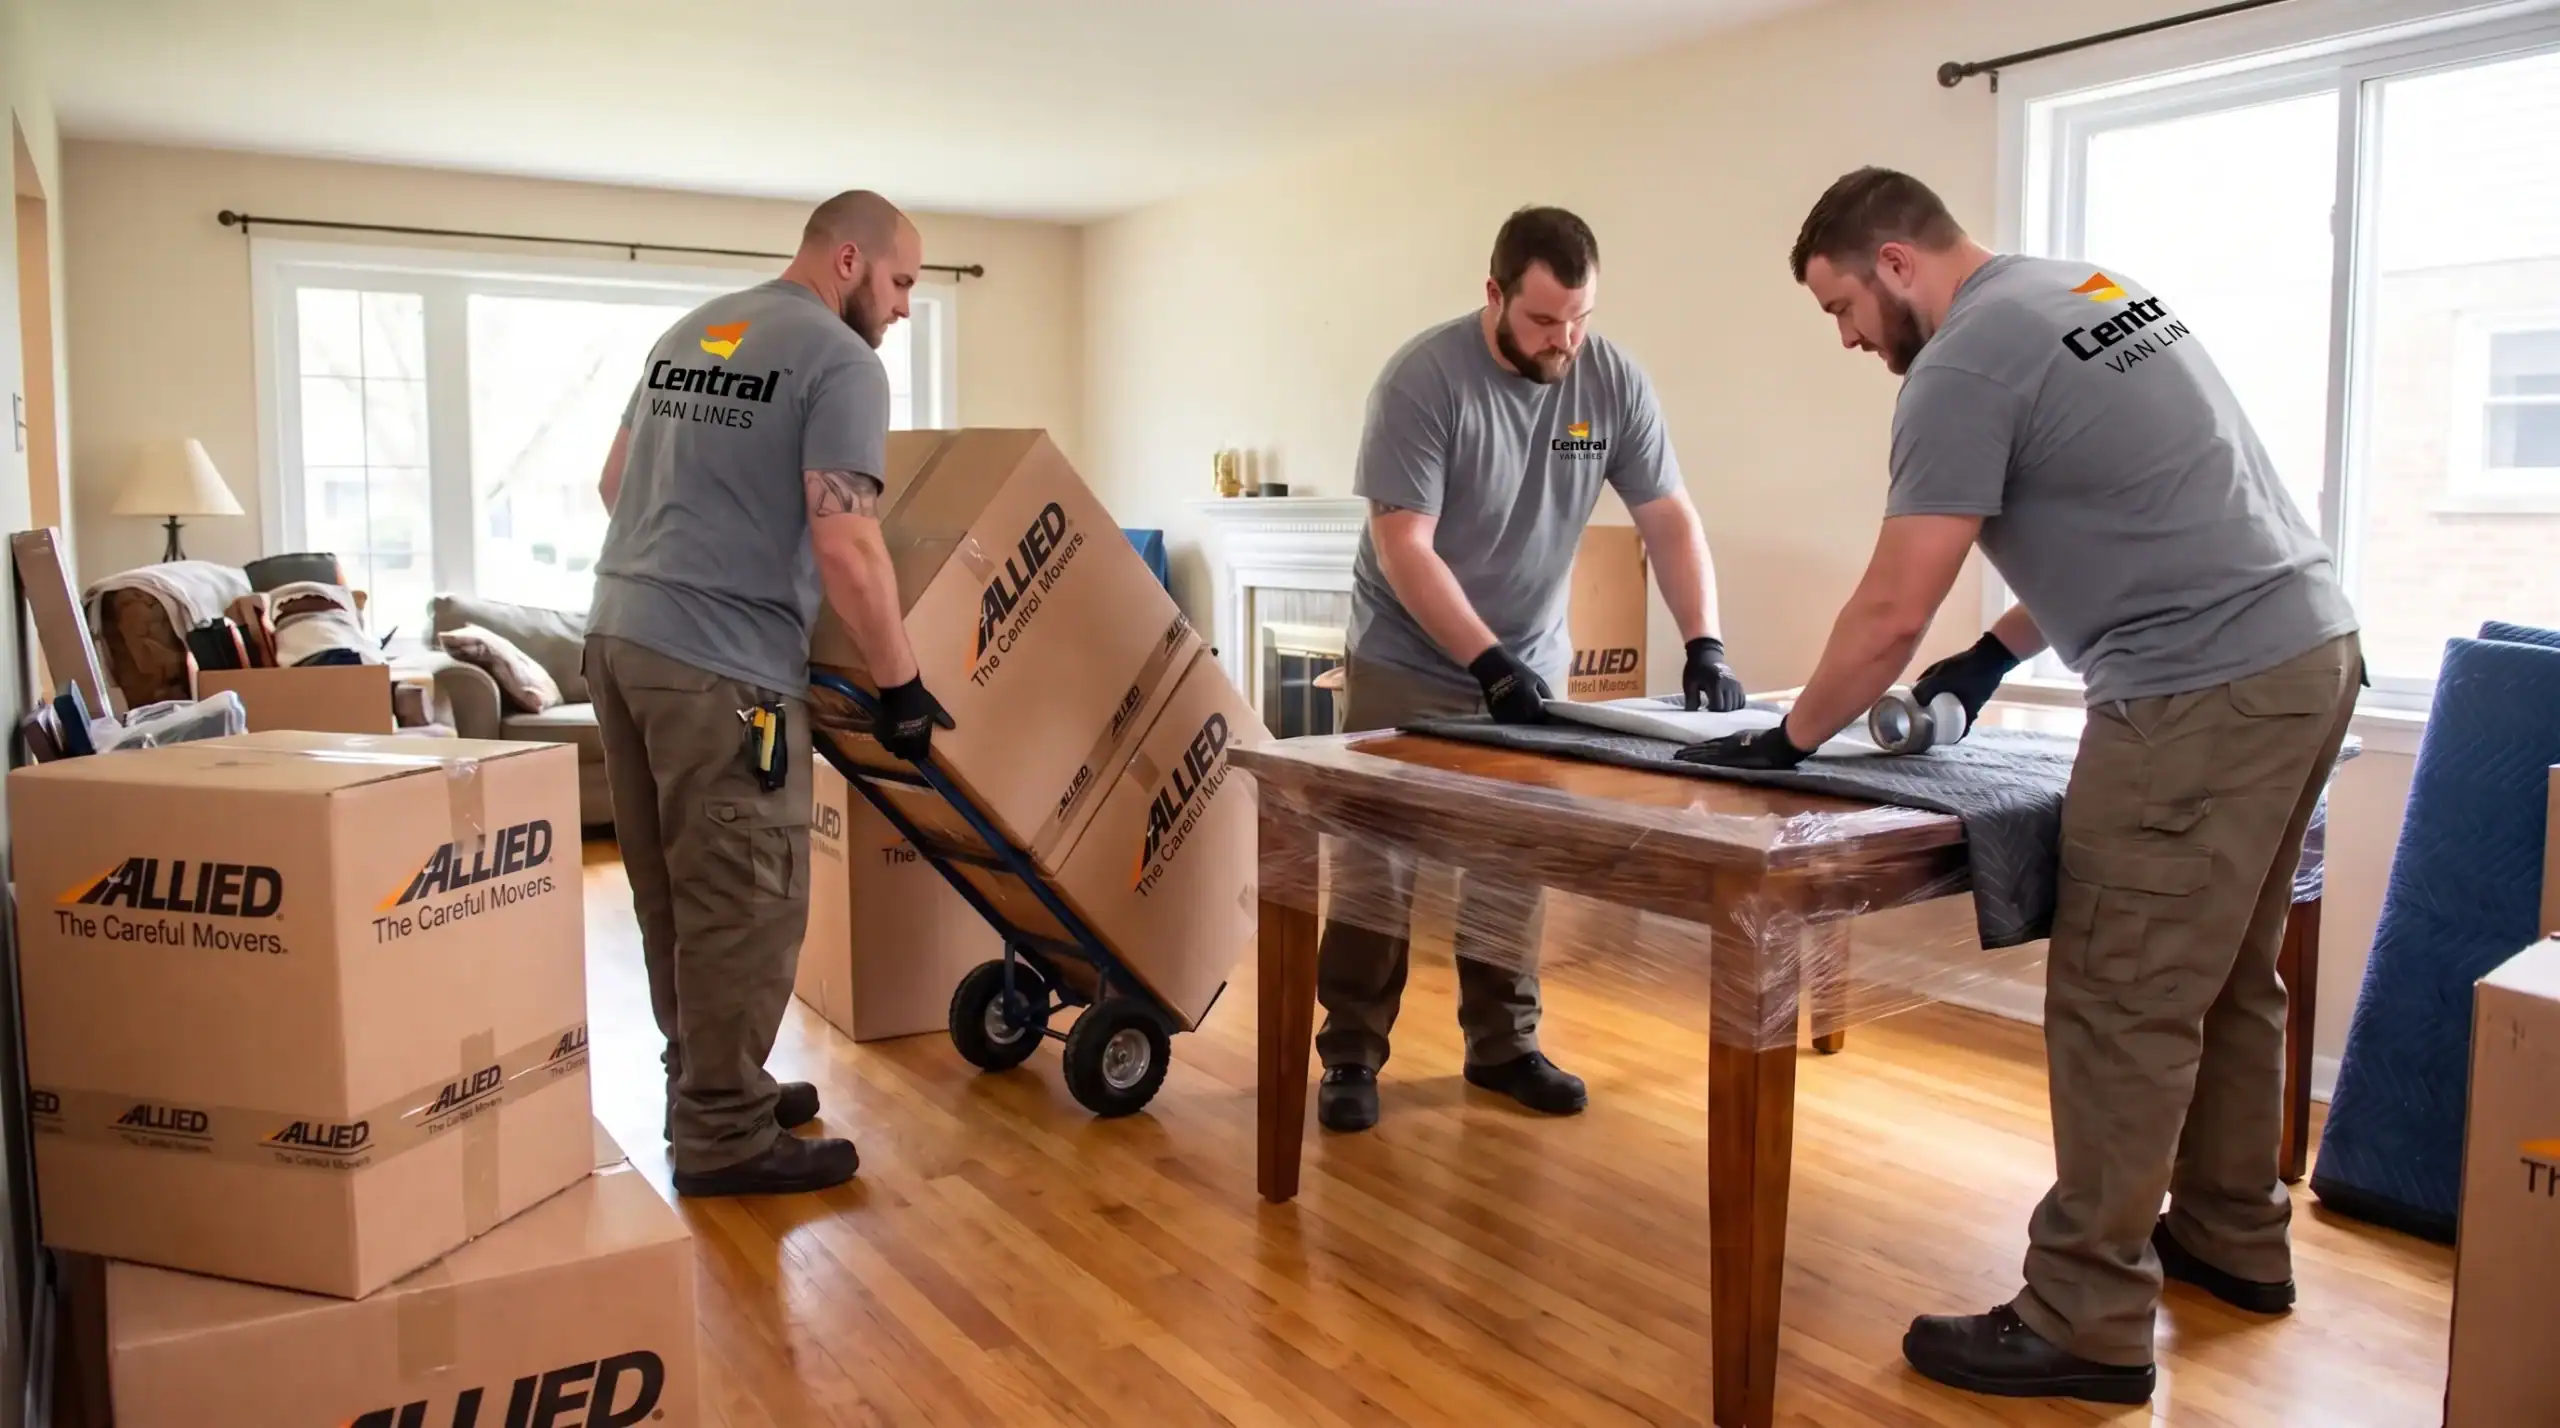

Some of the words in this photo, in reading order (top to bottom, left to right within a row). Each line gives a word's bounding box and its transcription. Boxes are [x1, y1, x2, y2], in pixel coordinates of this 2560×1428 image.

[2105, 339, 2157, 373] VAN
[648, 360, 780, 404] Central
[651, 398, 687, 420] VAN
[692, 403, 754, 429] LINES
[1552, 438, 1607, 451] Central
[976, 502, 1066, 662] ALLIED
[970, 654, 1001, 688] The
[1111, 685, 1140, 738] ALLIED
[1057, 765, 1088, 820] ALLIED
[1141, 712, 1228, 872] ALLIED
[811, 802, 841, 840] LIED
[395, 819, 553, 906] ALLIED
[882, 848, 917, 866] The
[1134, 864, 1164, 897] The
[1161, 796, 1207, 862] Careful
[76, 857, 284, 919] ALLIED
[54, 910, 97, 939] The
[103, 914, 185, 946] Careful
[372, 915, 412, 944] The
[418, 893, 485, 930] Careful
[425, 1064, 502, 1116] ALLIED
[116, 1104, 208, 1133] ALLIED
[272, 1120, 369, 1149] ALLIED
